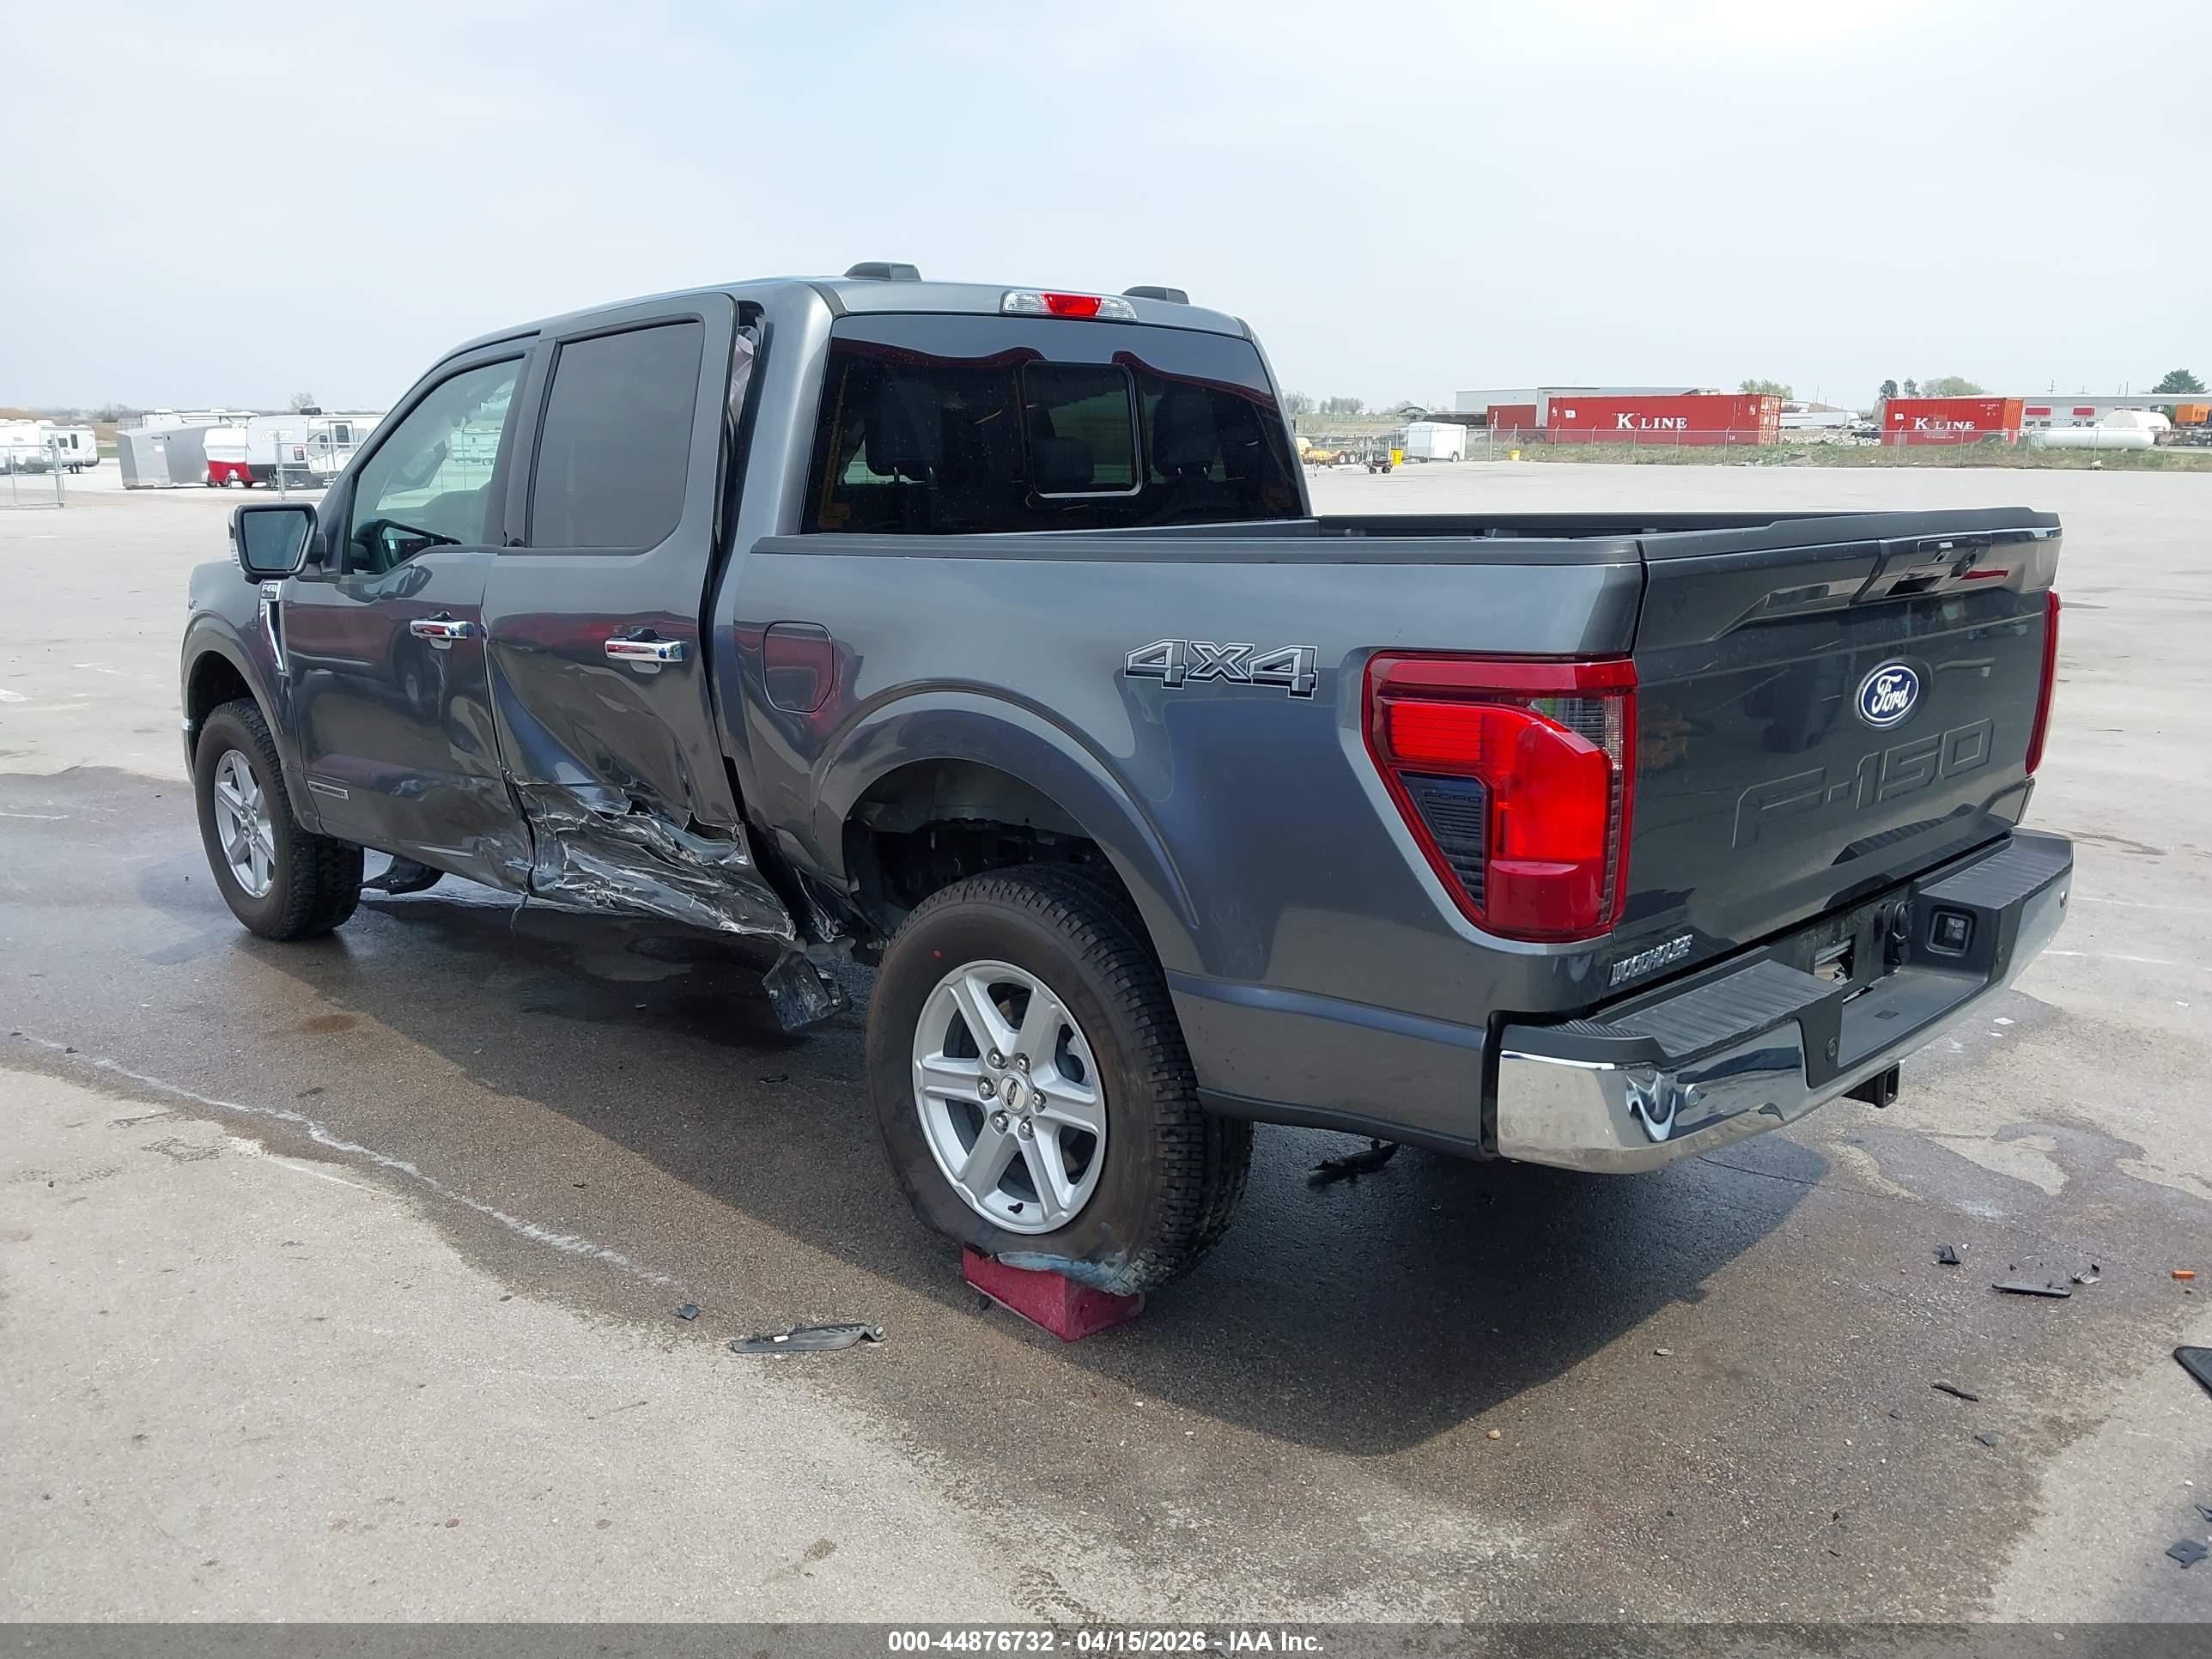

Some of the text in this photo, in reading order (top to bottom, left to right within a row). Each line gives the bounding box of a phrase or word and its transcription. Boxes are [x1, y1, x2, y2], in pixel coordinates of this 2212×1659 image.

[1641, 417, 1687, 428] LINE
[1936, 421, 1975, 430] LINE
[1871, 675, 1911, 714] Ford
[1732, 718, 1995, 849] F-150
